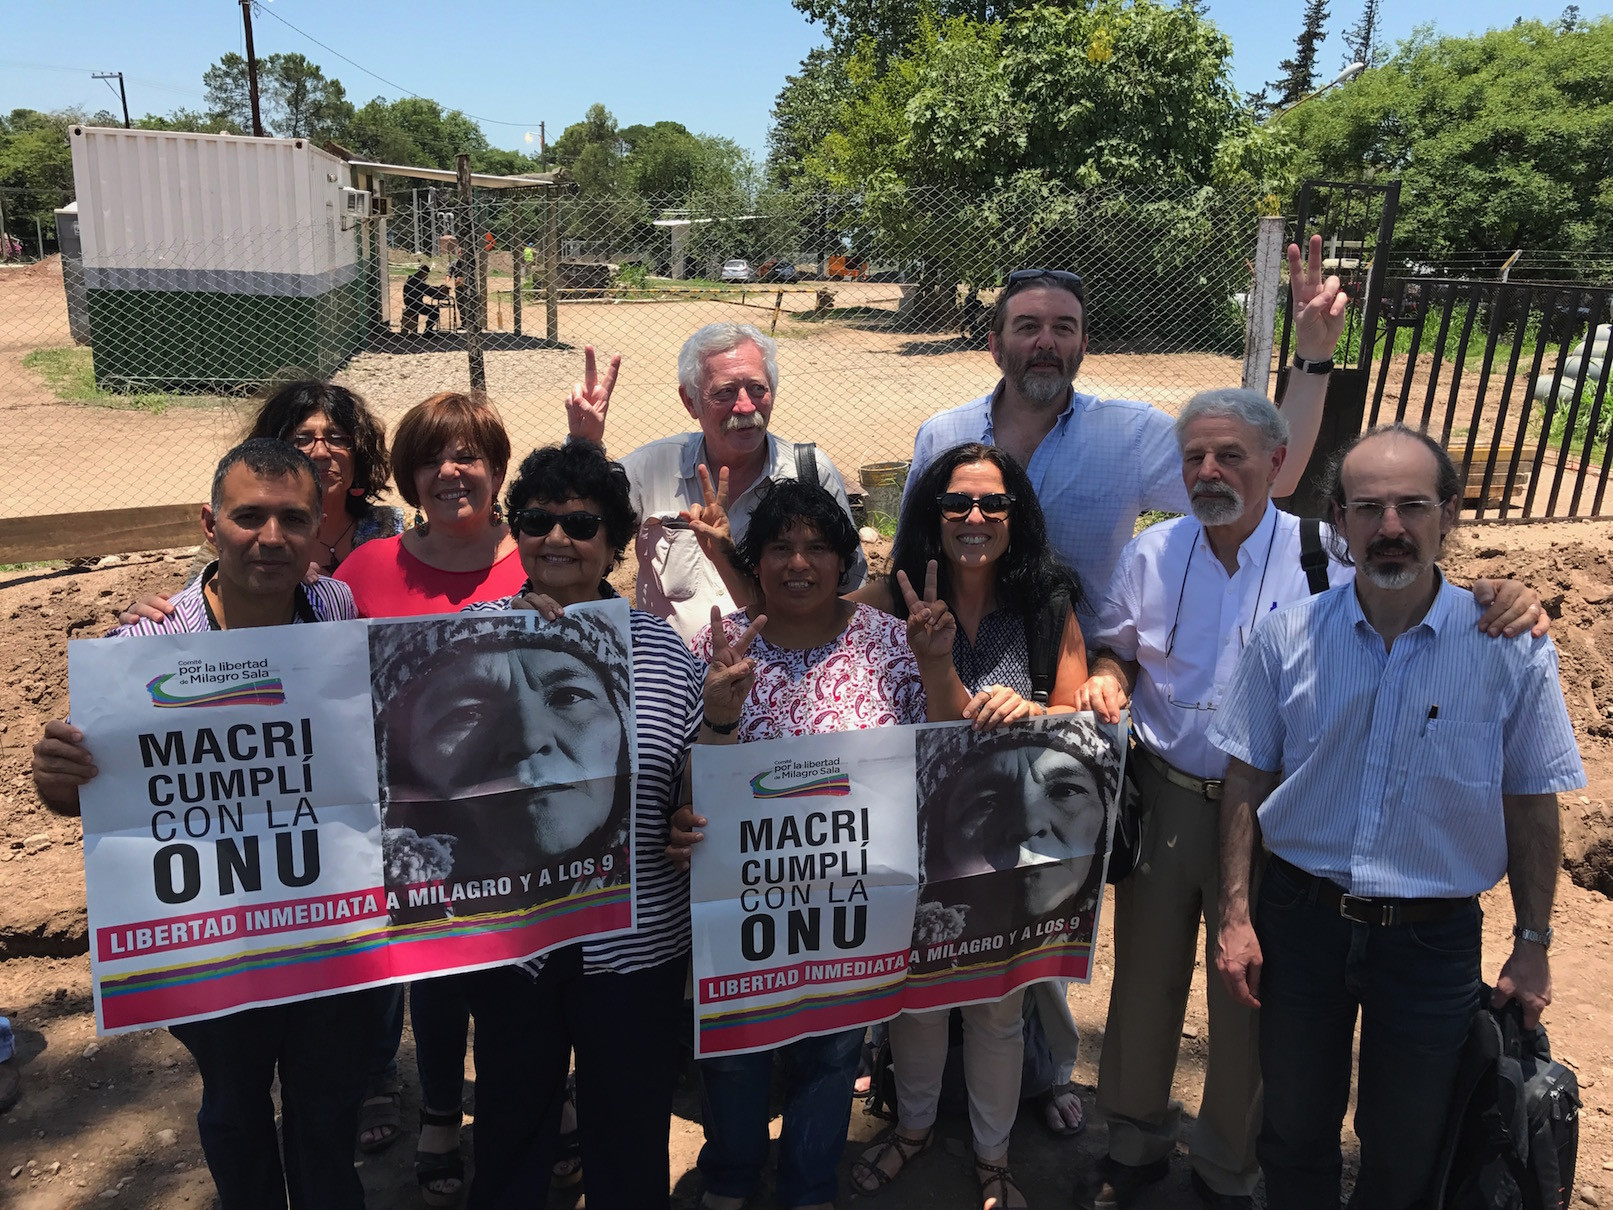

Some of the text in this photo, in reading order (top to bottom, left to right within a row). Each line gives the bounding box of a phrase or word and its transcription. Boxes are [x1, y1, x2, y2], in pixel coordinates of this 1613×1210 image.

[179, 658, 268, 676] por la libertad
[190, 673, 240, 684] Milagro
[242, 669, 269, 679] Sala
[138, 718, 313, 768] MACRI
[774, 757, 840, 773] por la libertad
[148, 755, 313, 806] CUMPLÍ
[781, 770, 818, 779] Milagro
[820, 766, 840, 775] Sala
[151, 797, 319, 842] CON LA
[740, 807, 869, 853] MACRI
[153, 829, 321, 904] ONU
[741, 841, 869, 886] CUMPLÍ
[110, 854, 614, 954] LIBERTAD INMEDIATA A MILAGRO Y A LOS 9
[740, 879, 869, 912] CON LA
[741, 905, 867, 962] ONU
[708, 916, 1080, 999] LIBERTAD INMEDIATA A MILAGRO Y A LOS 9
